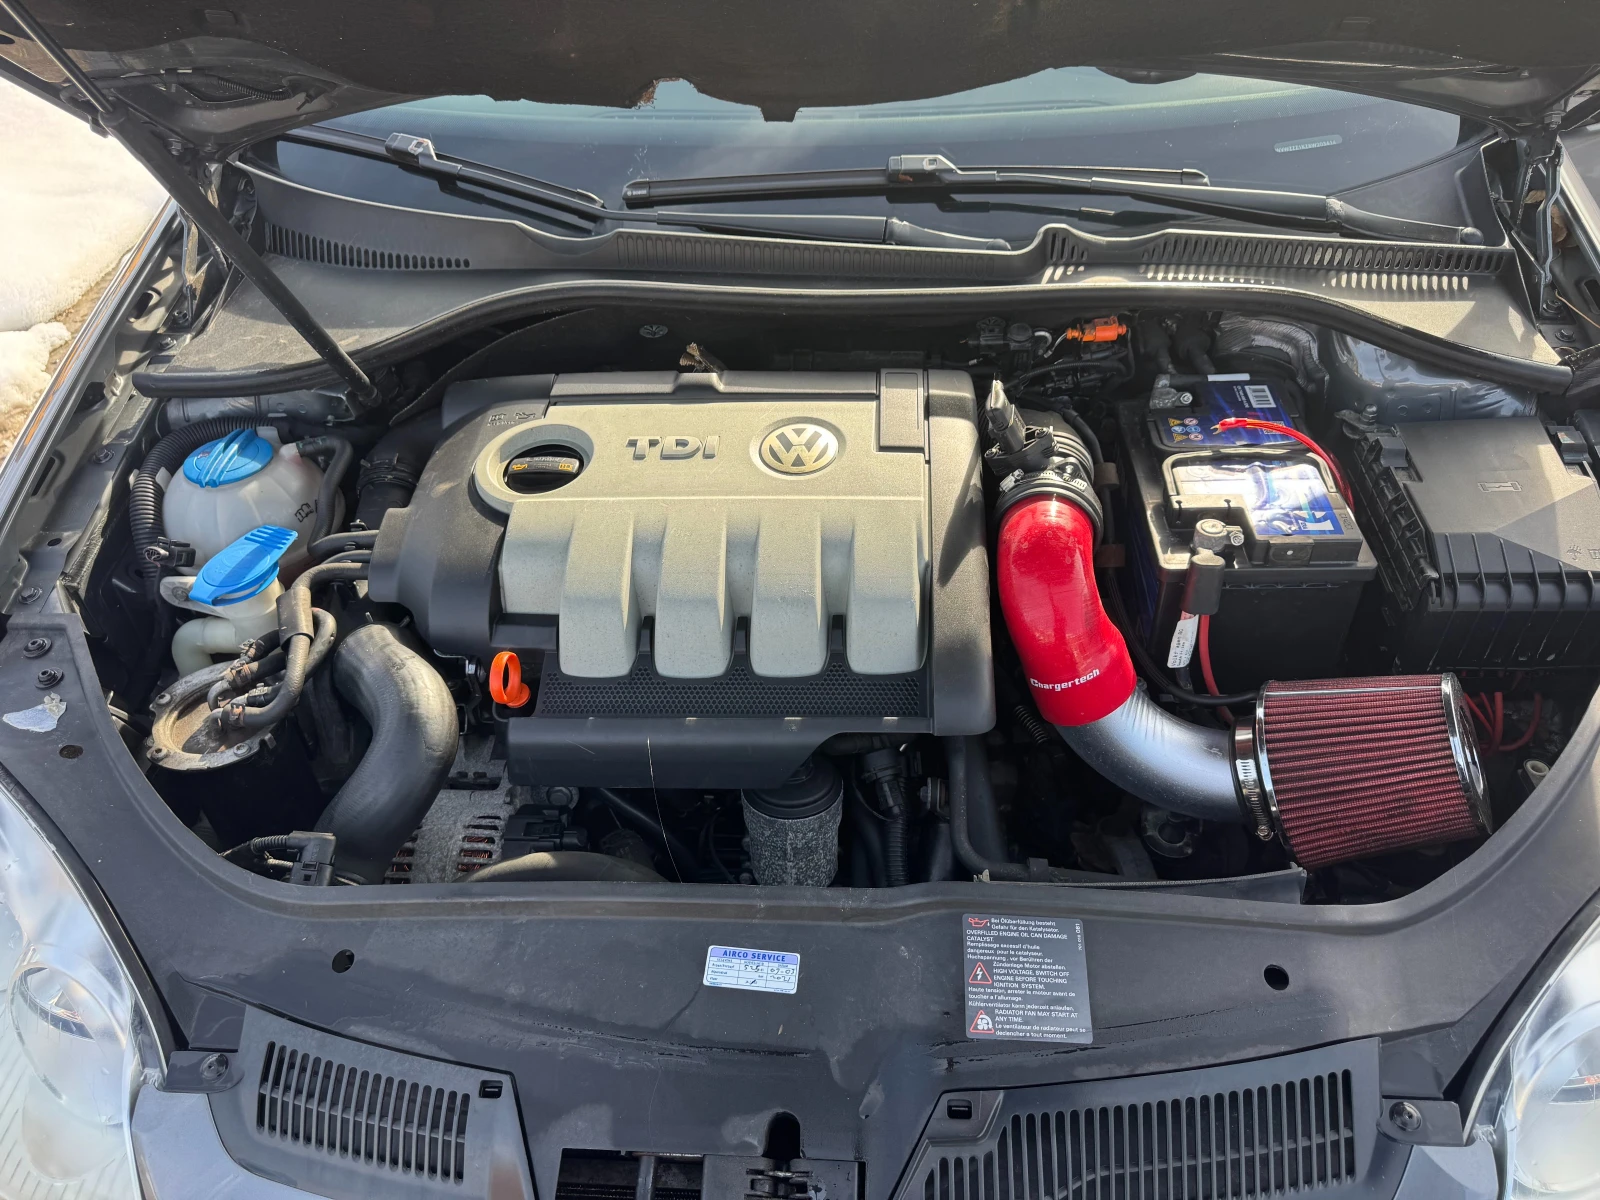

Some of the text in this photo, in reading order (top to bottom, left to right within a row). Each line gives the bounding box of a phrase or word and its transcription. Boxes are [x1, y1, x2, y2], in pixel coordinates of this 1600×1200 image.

[625, 435, 721, 460] TDI
[1029, 668, 1100, 692] Chargertech
[722, 949, 786, 963] AIRCO SERVICE
